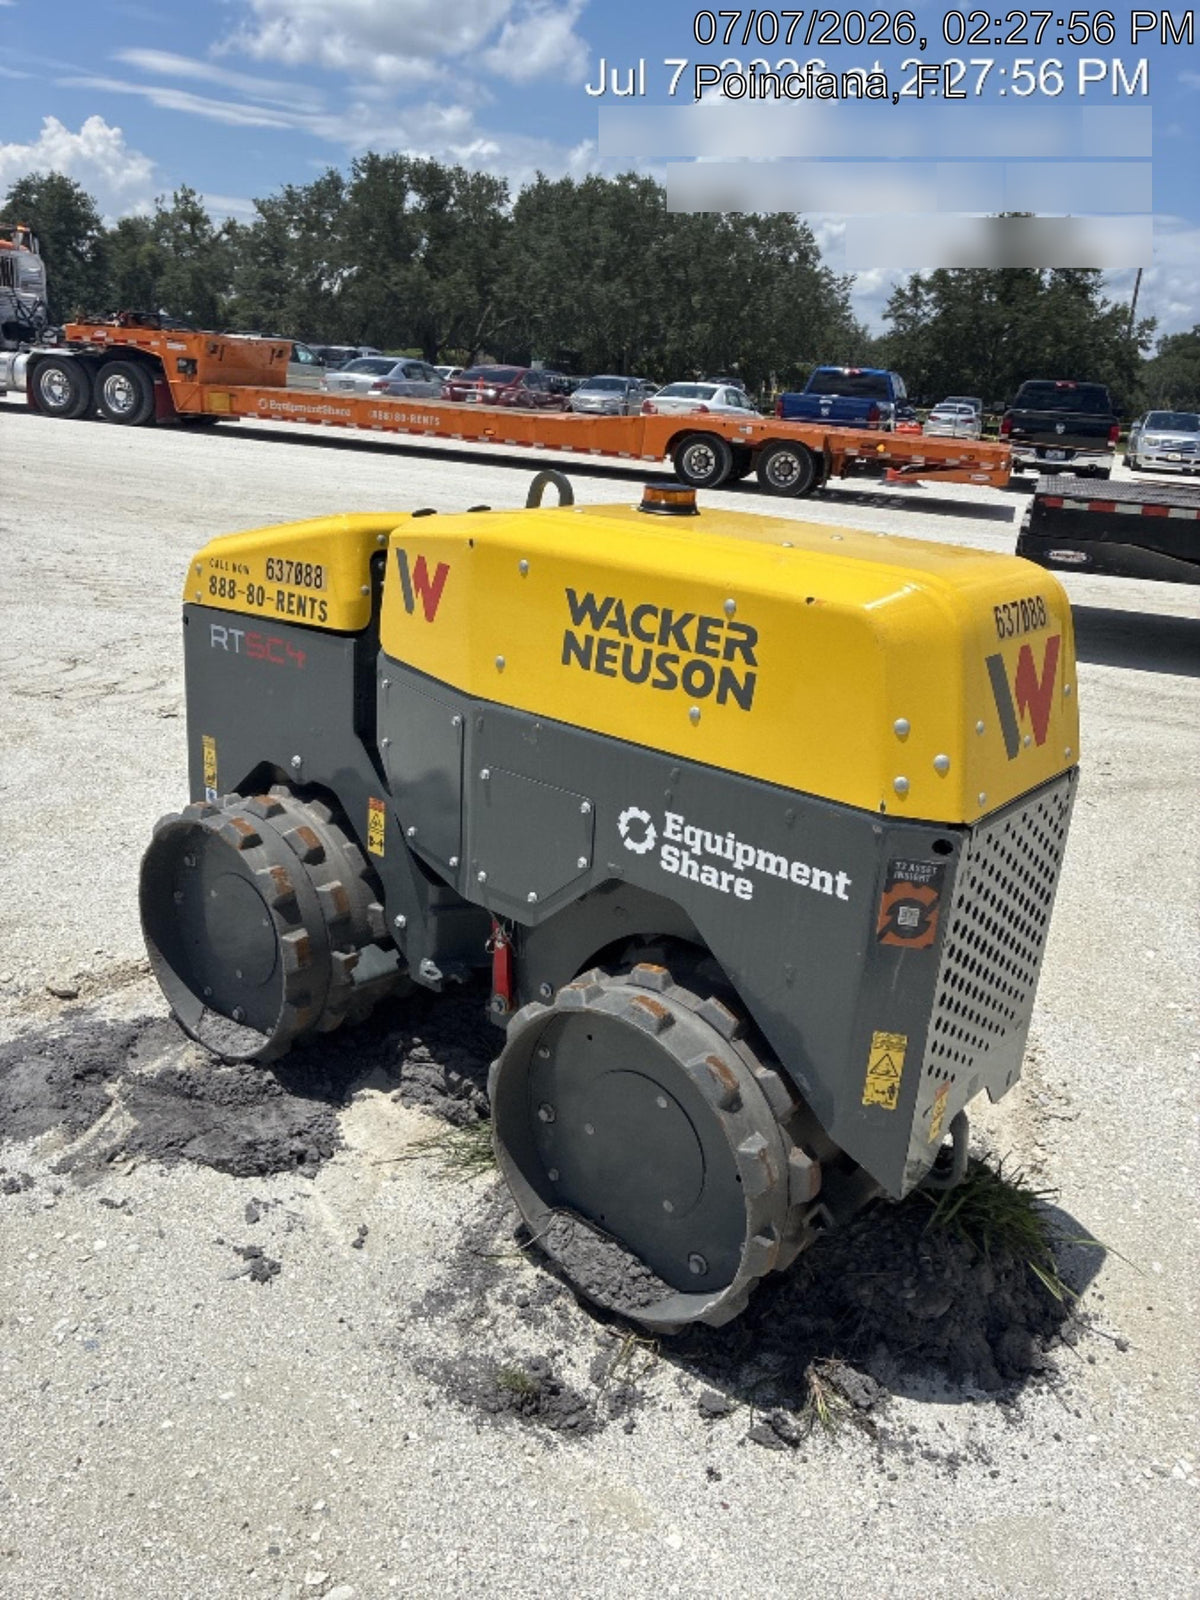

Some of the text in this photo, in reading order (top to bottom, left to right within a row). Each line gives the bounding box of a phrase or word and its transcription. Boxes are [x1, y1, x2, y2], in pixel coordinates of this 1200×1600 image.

[208, 558, 230, 572] CALL
[265, 557, 323, 589] 637088
[208, 575, 328, 623] 888-80-RENTS
[993, 595, 1047, 640] 637088
[565, 587, 759, 667] WACKER
[561, 629, 757, 712] NEUSON
[660, 843, 754, 901] Share
[662, 811, 852, 901] Equipment
